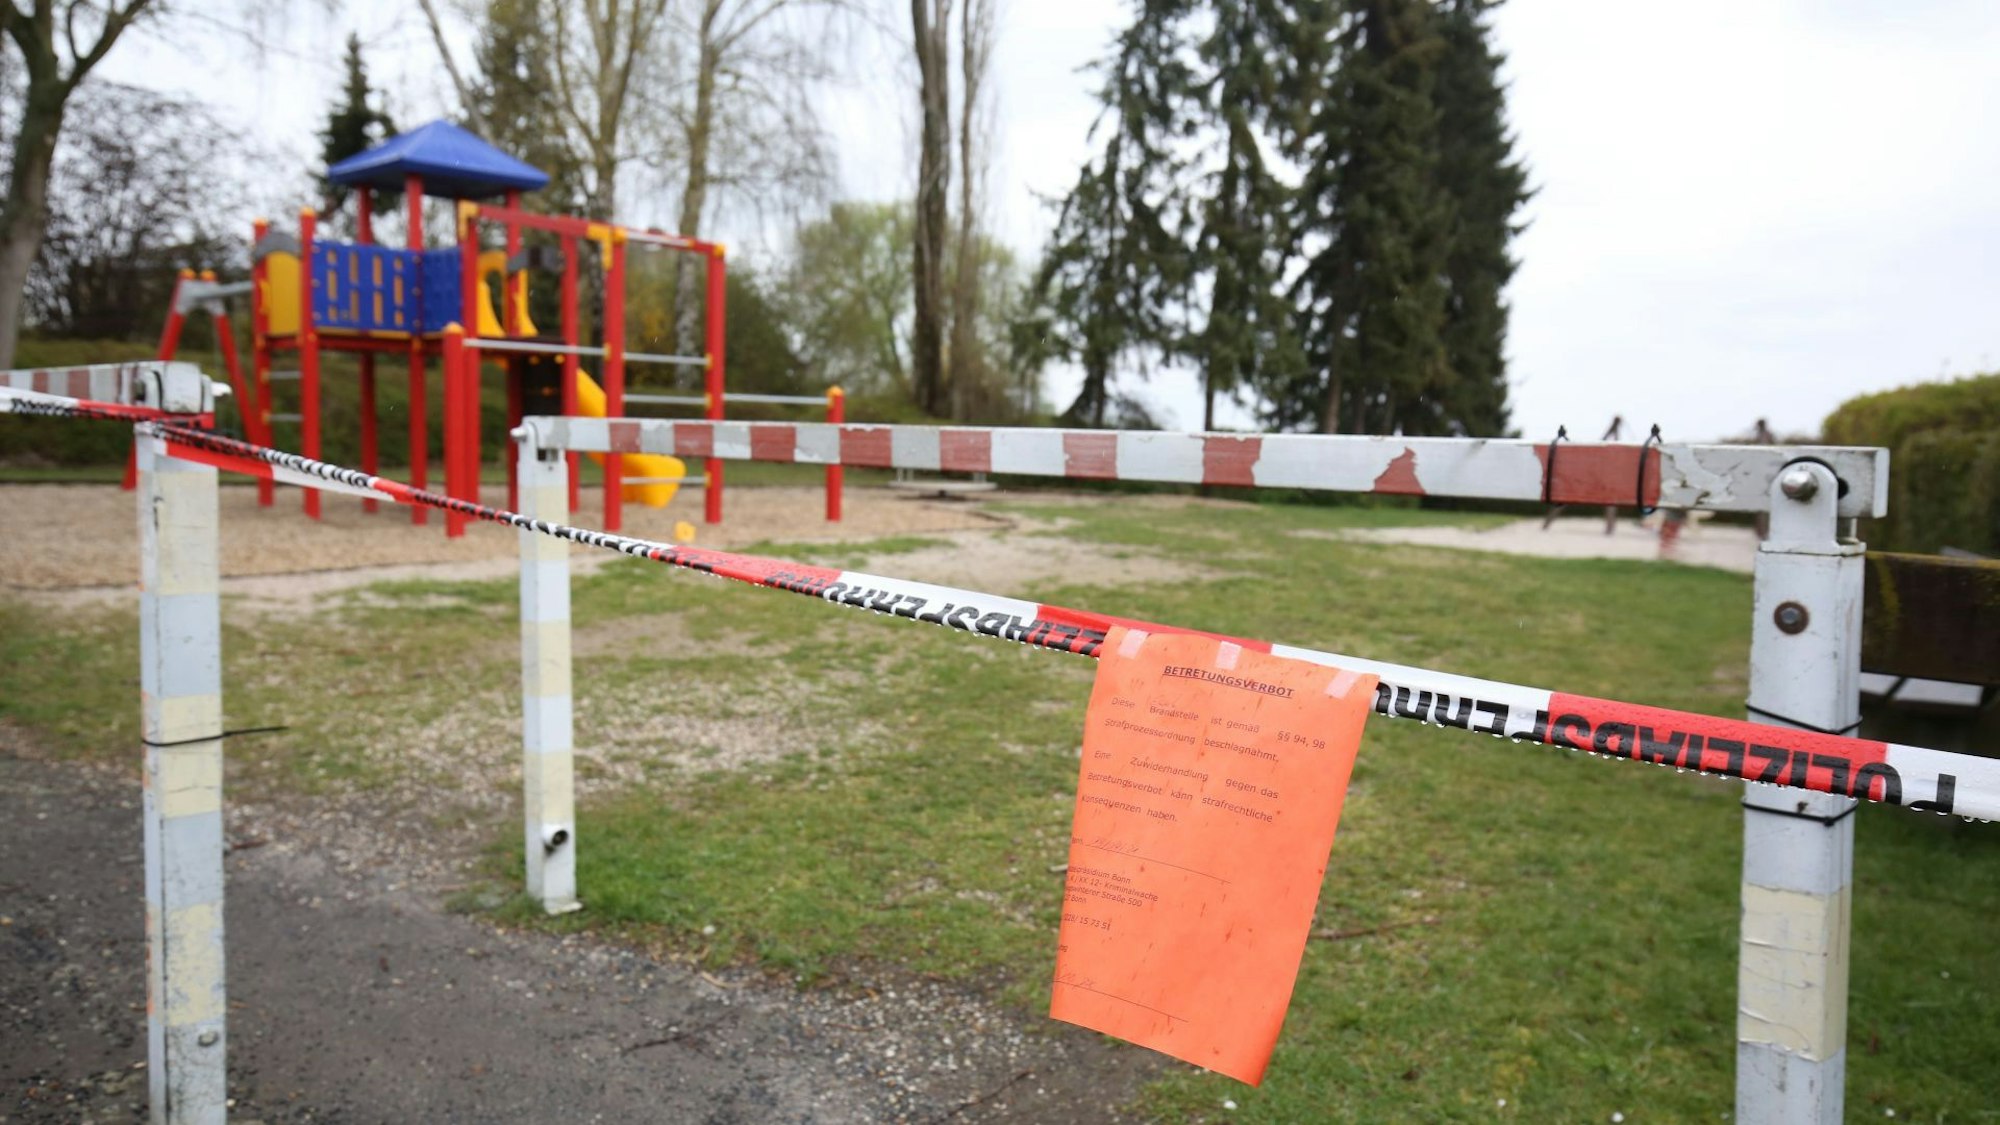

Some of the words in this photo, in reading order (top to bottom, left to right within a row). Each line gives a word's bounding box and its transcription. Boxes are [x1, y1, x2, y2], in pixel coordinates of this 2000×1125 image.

[1163, 665, 1295, 697] BETRETUNGSVERBOT
[1104, 718, 1196, 744] Strafprozessordnung
[1111, 697, 1135, 709] Diese
[1149, 705, 1199, 721] Brandstelle
[1211, 717, 1222, 726] ist
[1277, 730, 1291, 743] §§
[1294, 734, 1309, 748] 94,
[1312, 739, 1326, 750] 98
[1130, 757, 1208, 782] Zuwiderhandlung
[1226, 777, 1256, 793] gegen
[1260, 787, 1279, 800] das
[1147, 807, 1178, 822] haben.
[1171, 789, 1193, 801] kann
[1202, 796, 1273, 823] strafrechtliche
[1112, 873, 1131, 884] Bonn
[1128, 898, 1143, 907] 500
